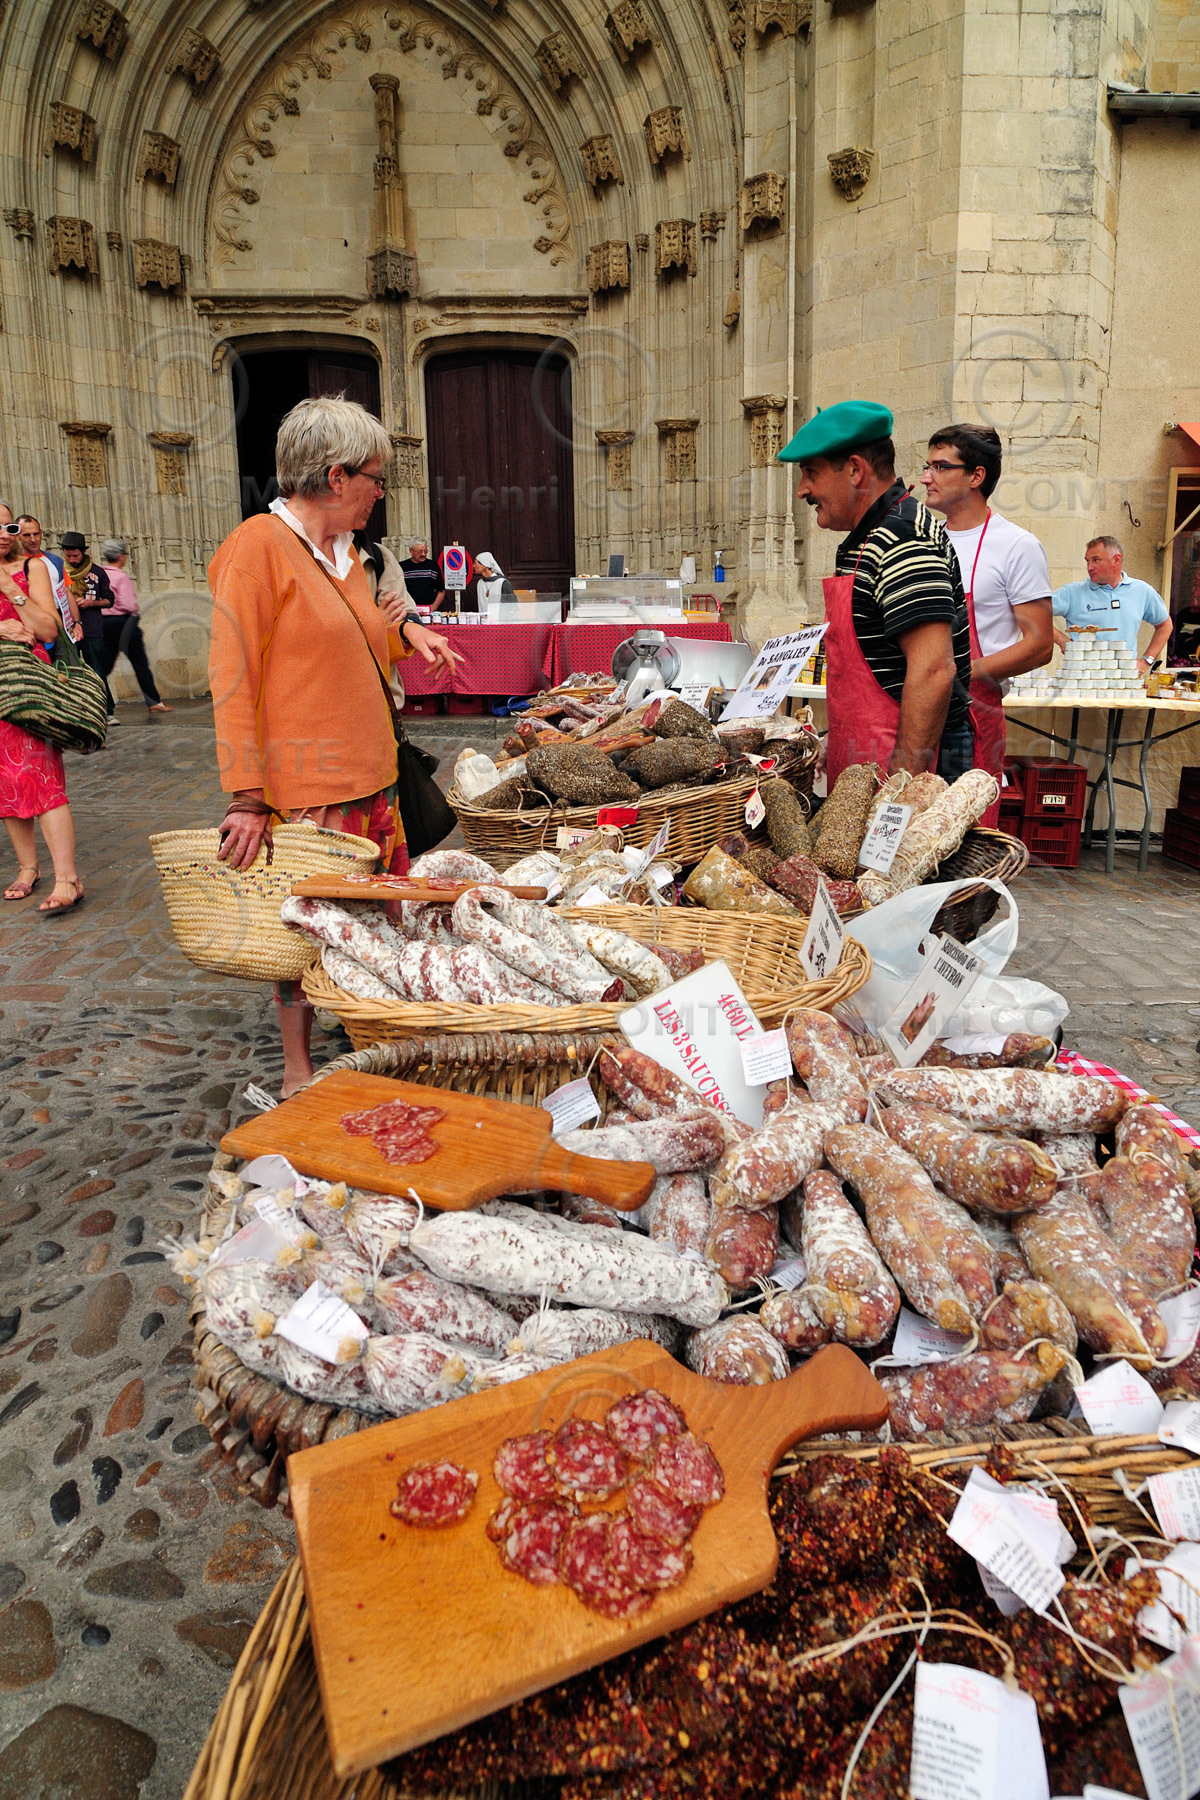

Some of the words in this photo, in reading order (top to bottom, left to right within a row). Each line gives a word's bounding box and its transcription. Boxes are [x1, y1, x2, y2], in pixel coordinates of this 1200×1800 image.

[766, 645, 811, 665] SANGLIER
[965, 957, 978, 973] de
[653, 999, 684, 1035] LES
[716, 993, 748, 1028] 4€60
[673, 1031, 691, 1047] 3
[678, 1042, 736, 1118] SAUCISS
